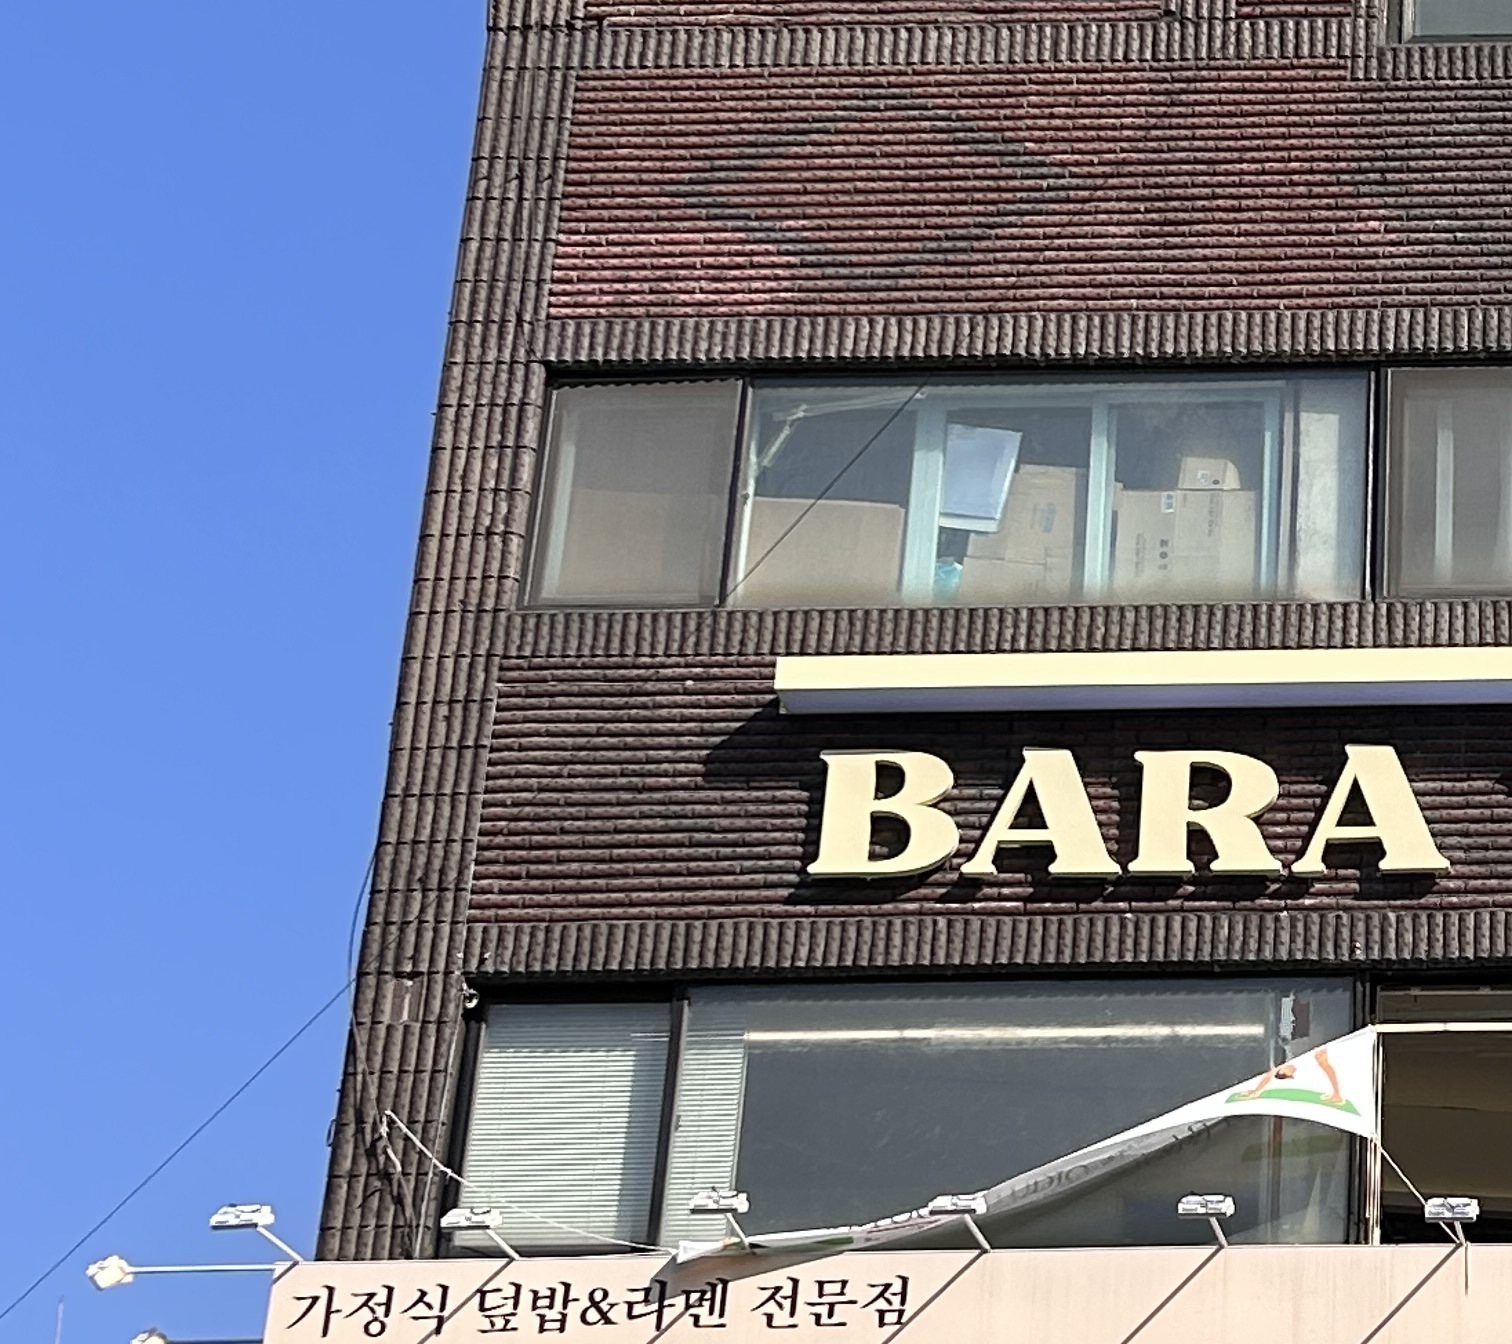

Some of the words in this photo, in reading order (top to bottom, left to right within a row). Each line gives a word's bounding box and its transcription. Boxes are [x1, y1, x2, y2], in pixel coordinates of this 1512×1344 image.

[804, 745, 1449, 881] BARA
[286, 1280, 449, 1338] 가정식
[475, 1276, 730, 1334] 덮밥&라멘
[750, 1273, 912, 1330] 전문점
